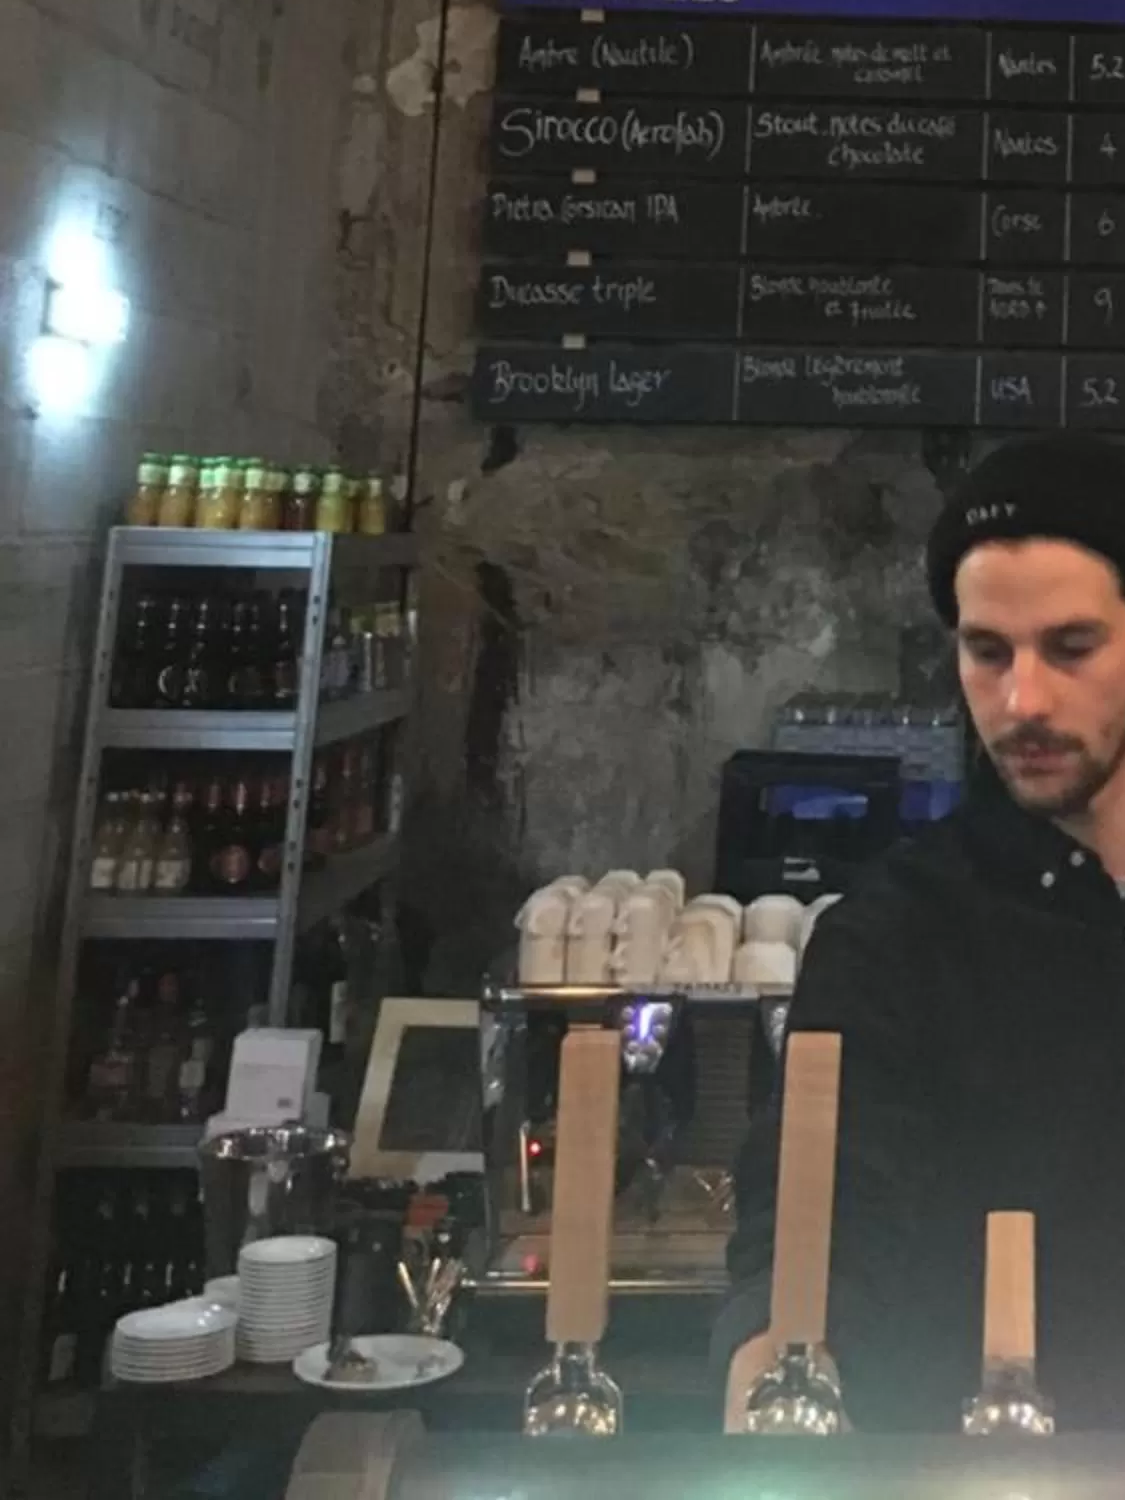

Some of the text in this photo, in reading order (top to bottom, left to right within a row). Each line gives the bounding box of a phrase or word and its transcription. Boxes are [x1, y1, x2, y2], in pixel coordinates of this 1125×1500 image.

[1099, 132, 1118, 160] 4
[1096, 210, 1115, 237] 6
[1094, 287, 1115, 326] 9
